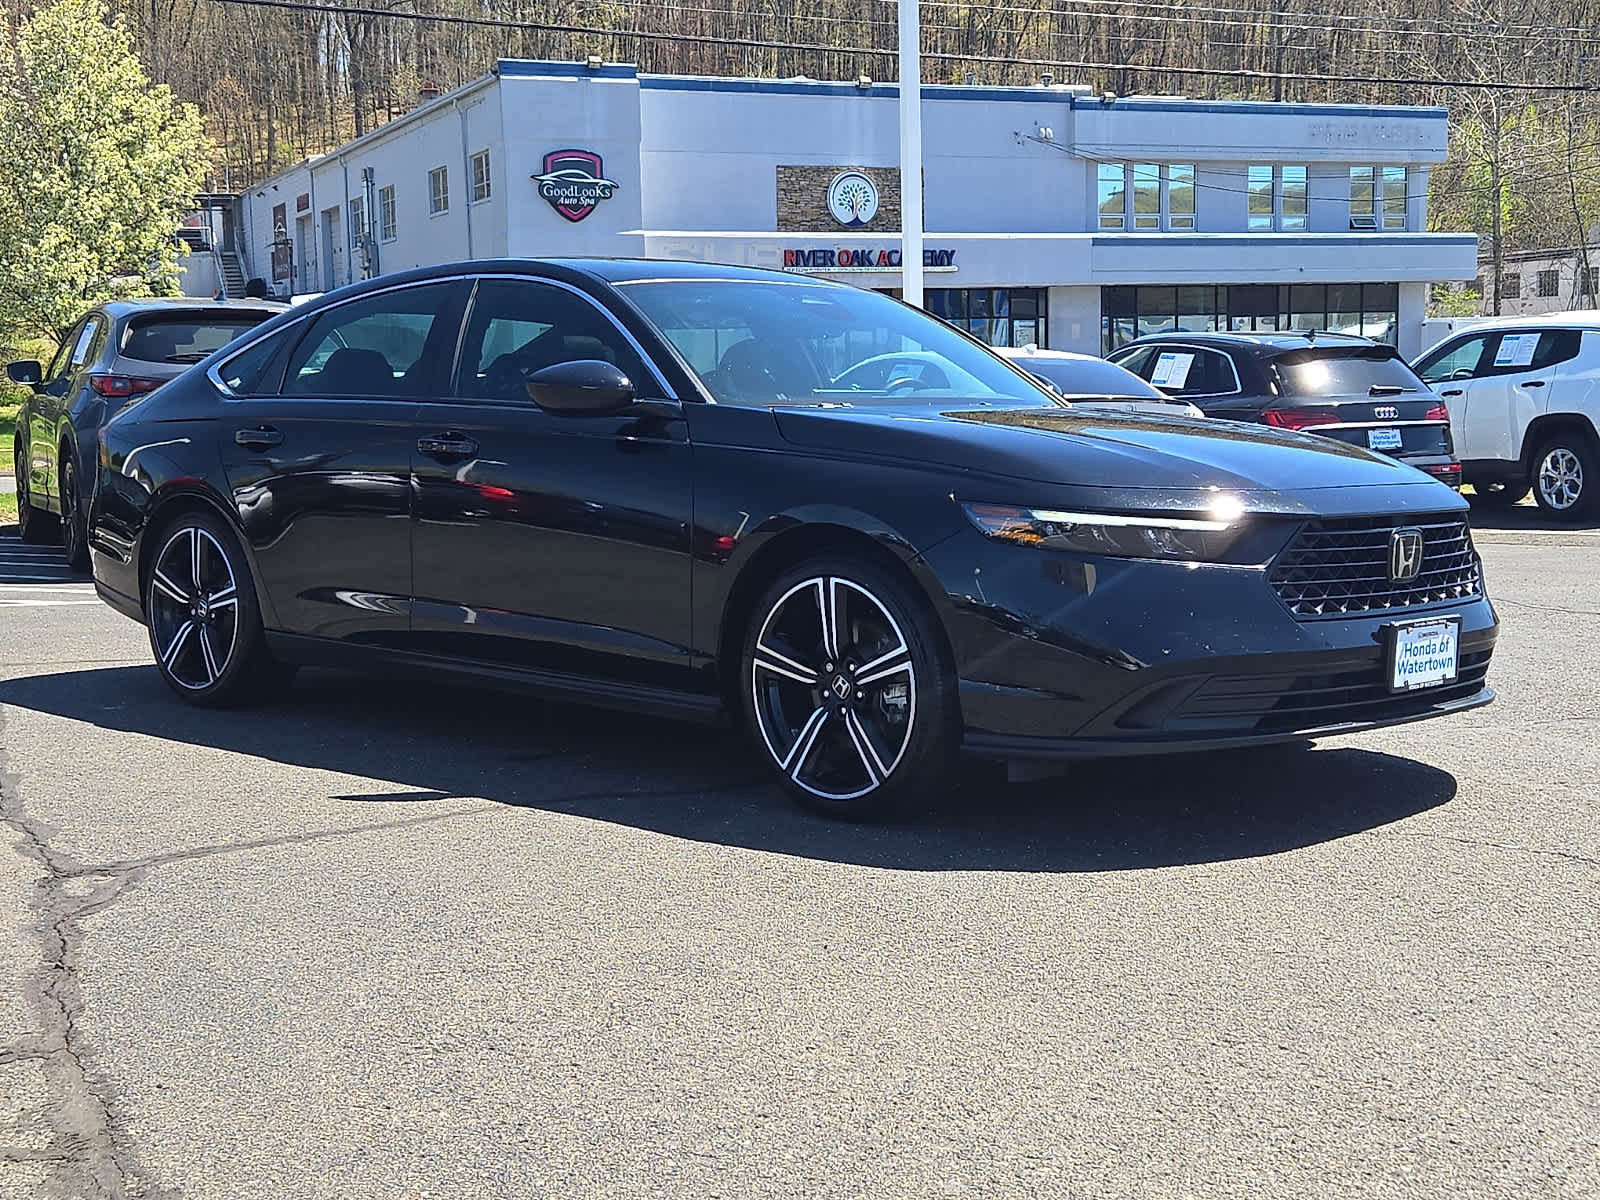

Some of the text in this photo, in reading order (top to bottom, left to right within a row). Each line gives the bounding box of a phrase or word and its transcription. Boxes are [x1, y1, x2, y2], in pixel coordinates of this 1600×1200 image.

[558, 197, 595, 206] Auto Spa
[784, 249, 835, 267] RIVER
[838, 249, 874, 267] OAK
[876, 249, 956, 267] ACEMY
[1404, 637, 1450, 658] Honda of
[1397, 657, 1453, 676] Watertown
